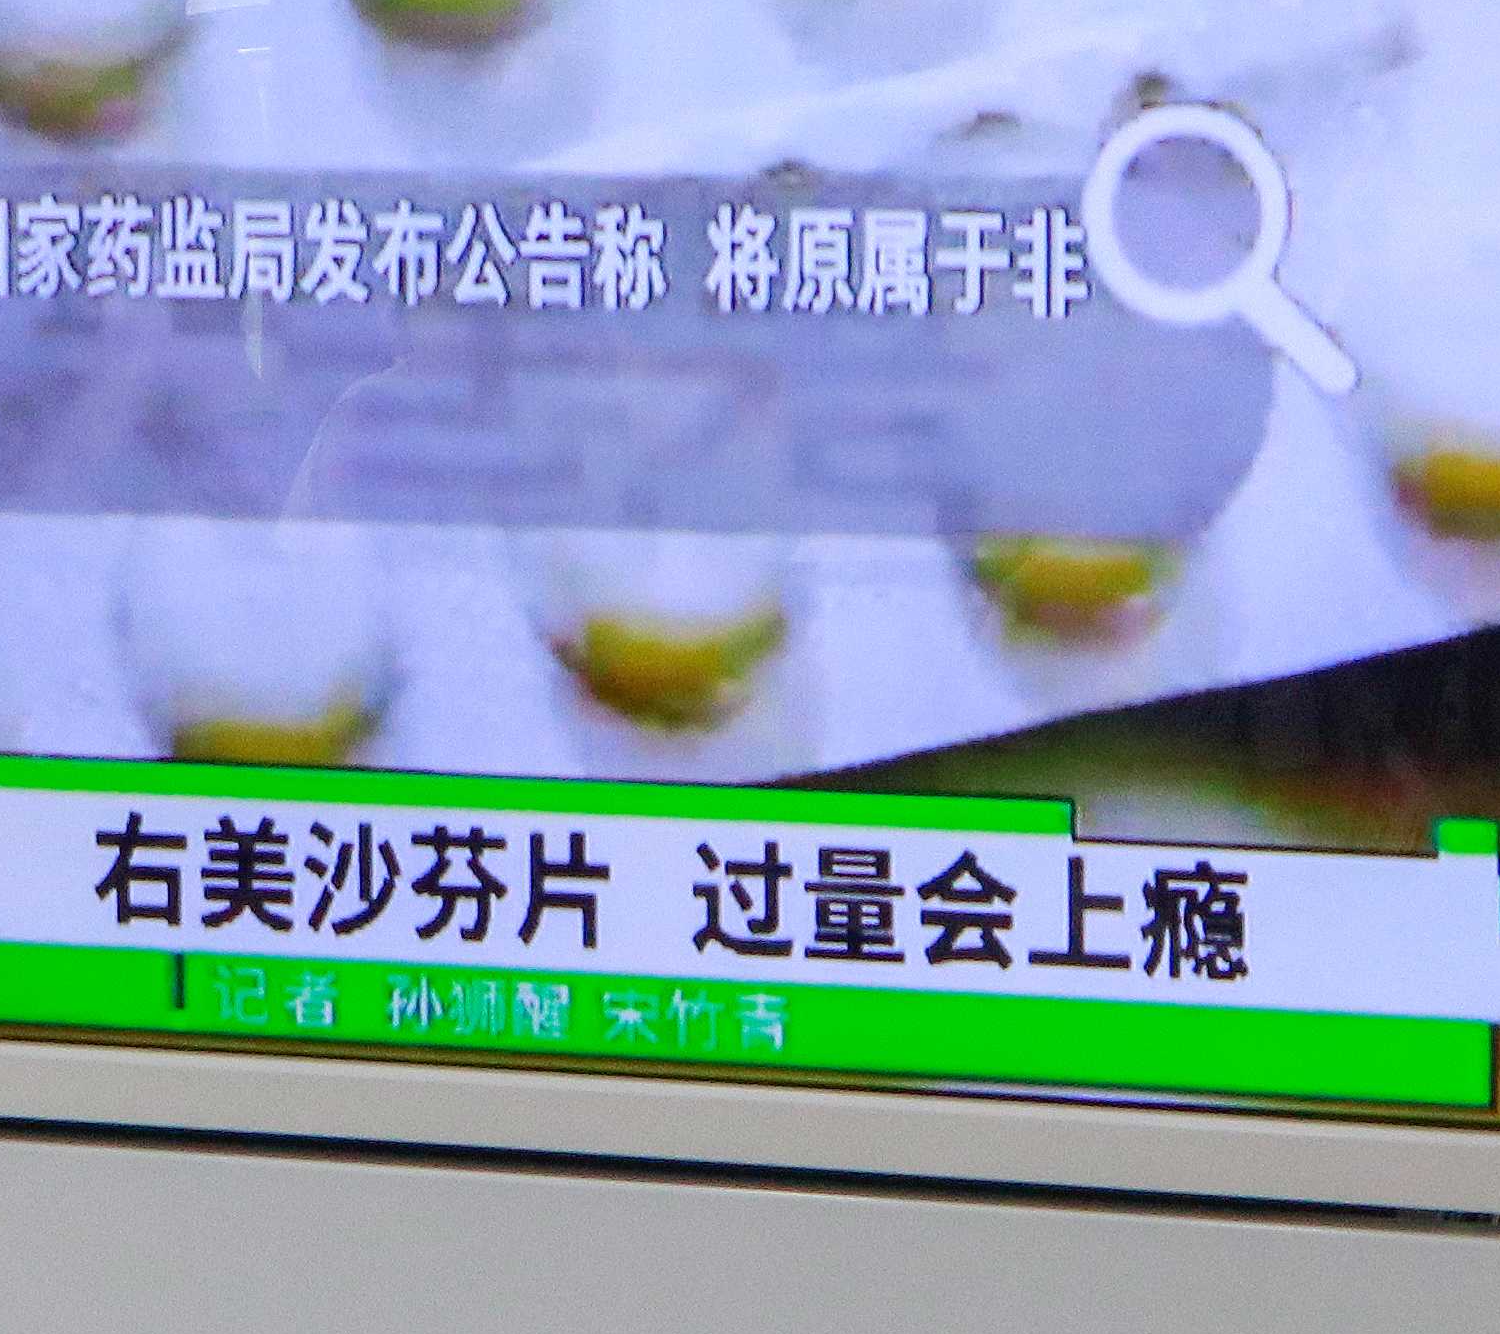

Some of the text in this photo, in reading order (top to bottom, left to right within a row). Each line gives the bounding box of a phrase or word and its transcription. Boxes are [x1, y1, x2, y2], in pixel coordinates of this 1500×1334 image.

[704, 202, 1091, 319] 将原属于非
[95, 811, 1251, 983] 右美沙芬片 过量会上瘾
[214, 966, 339, 1028] 记者
